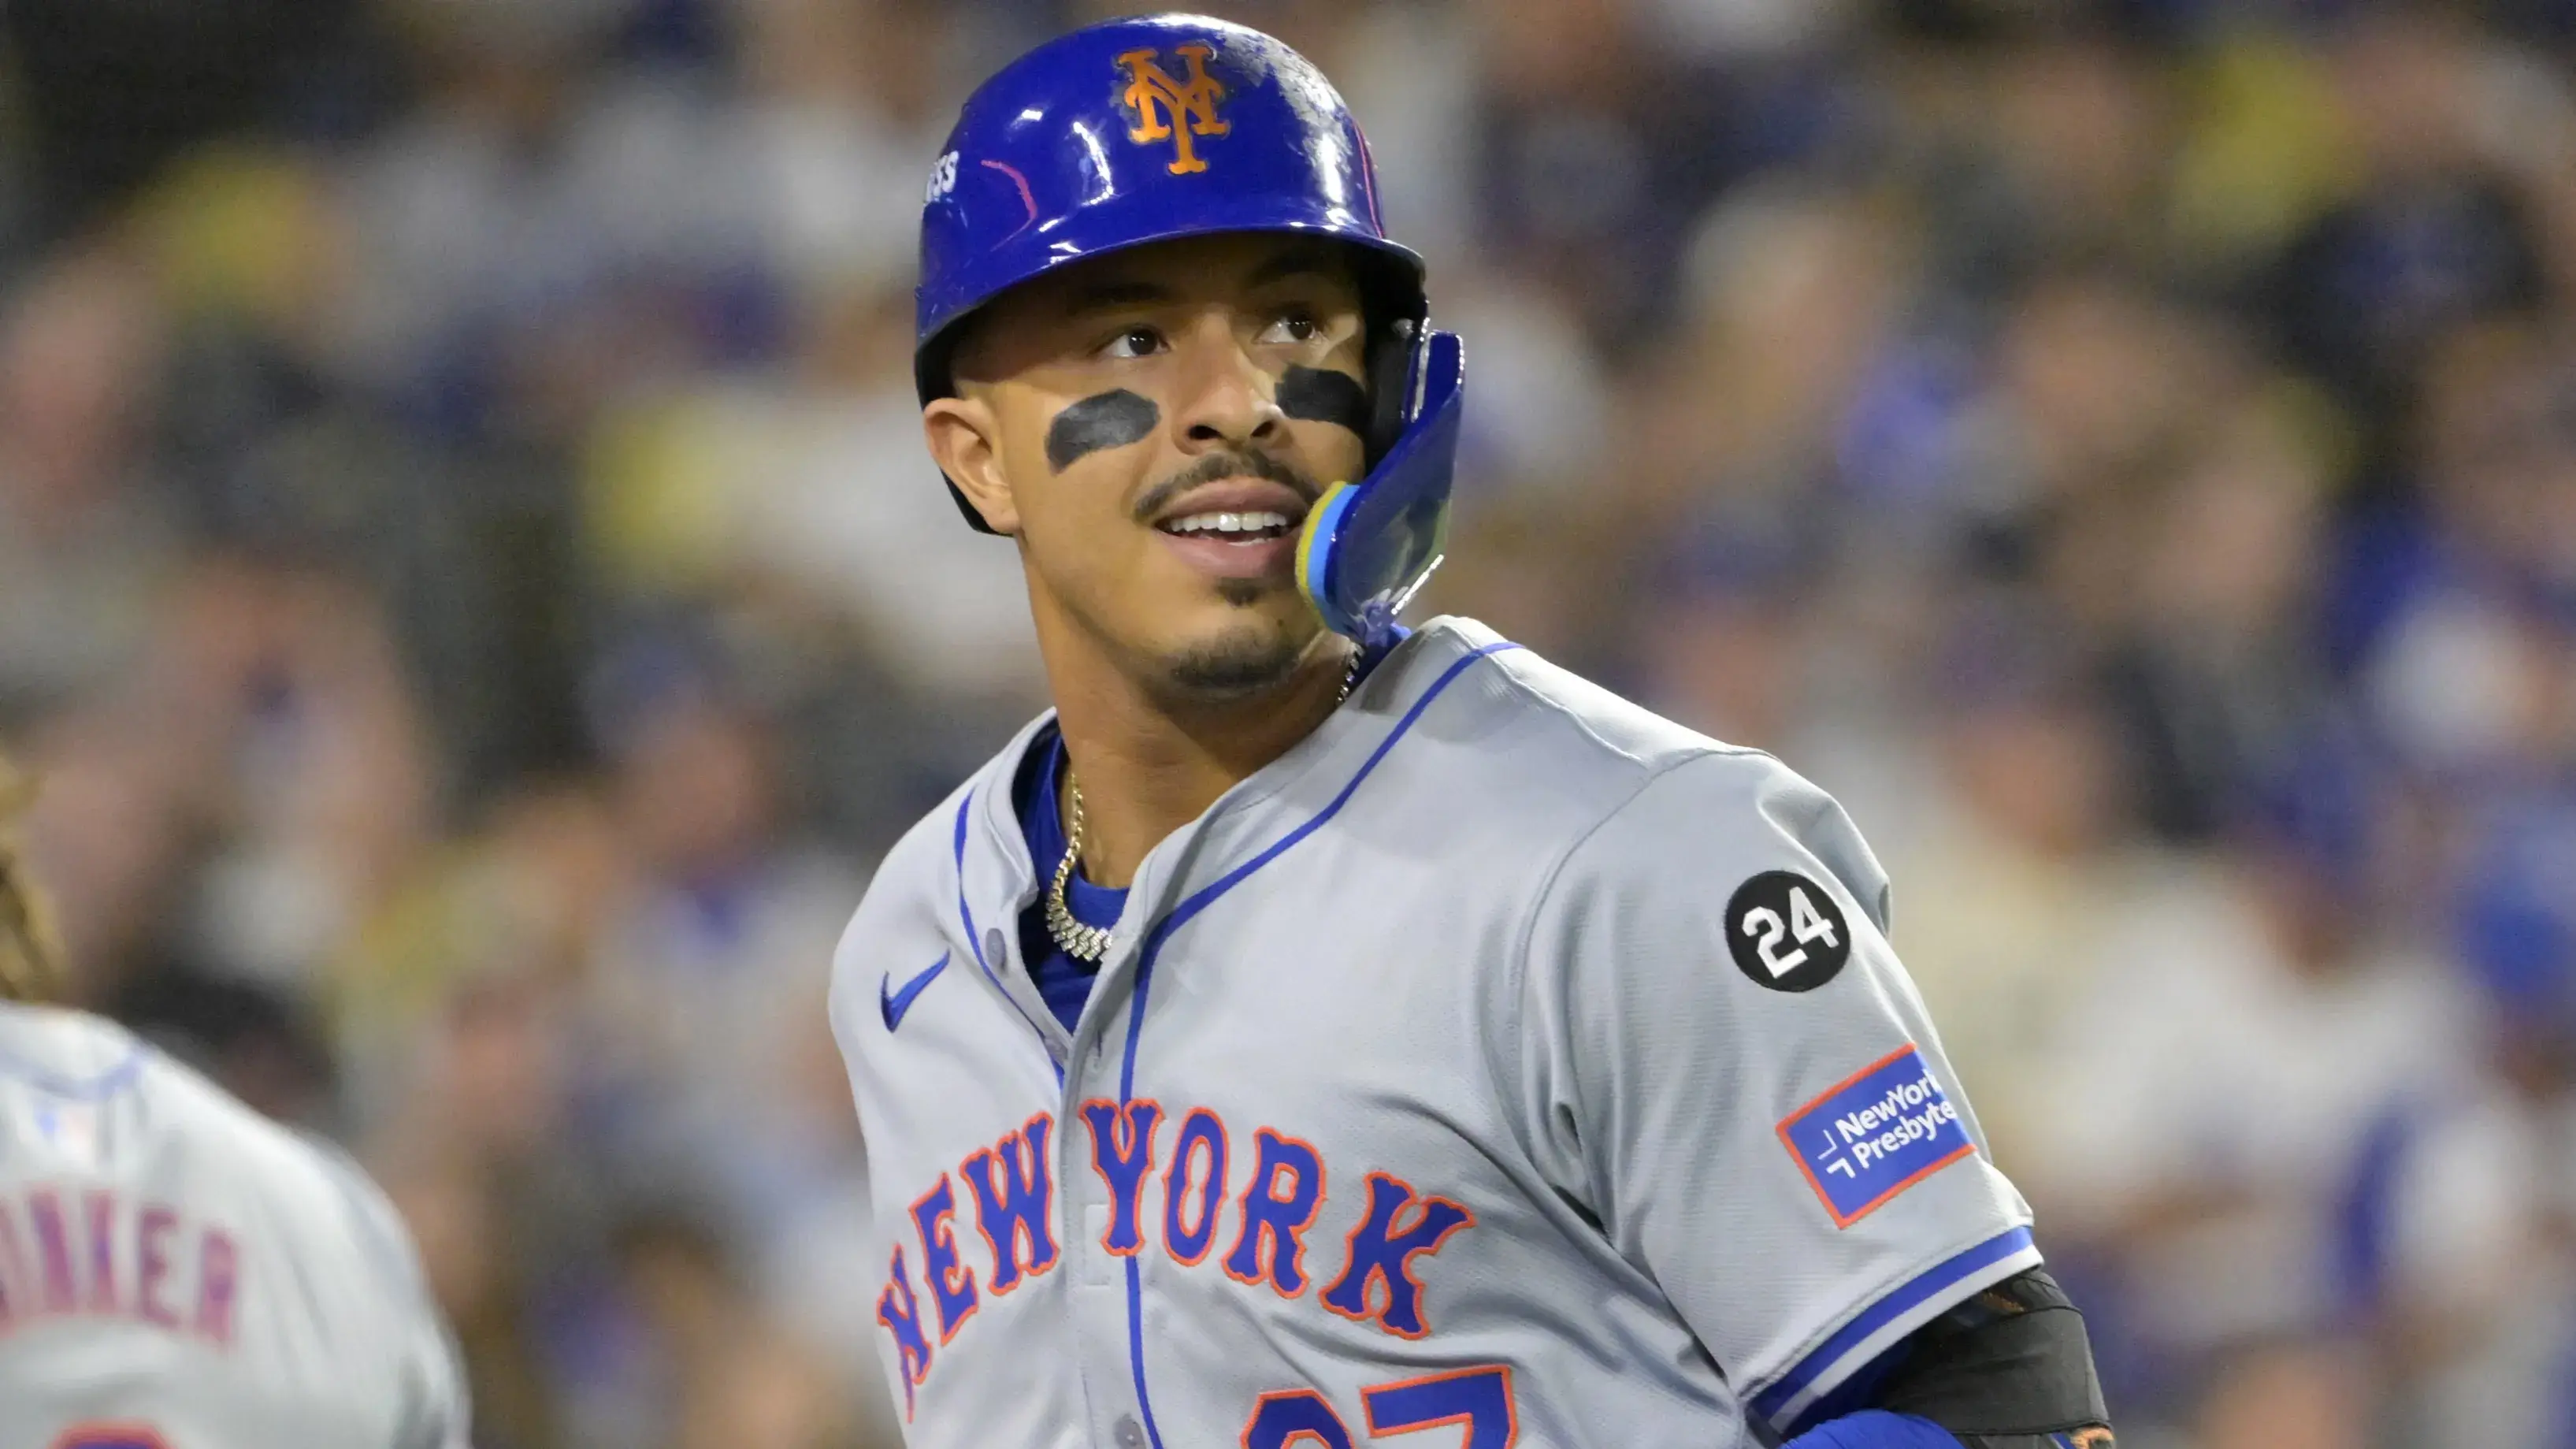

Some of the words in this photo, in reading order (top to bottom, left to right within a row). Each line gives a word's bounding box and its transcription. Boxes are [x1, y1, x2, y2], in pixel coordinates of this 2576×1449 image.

[1117, 43, 1231, 176] NY
[1742, 886, 1839, 979] 24
[0, 1180, 243, 1354] INKER
[877, 1111, 1060, 1423] NEW
[1078, 1098, 1476, 1340] YORK
